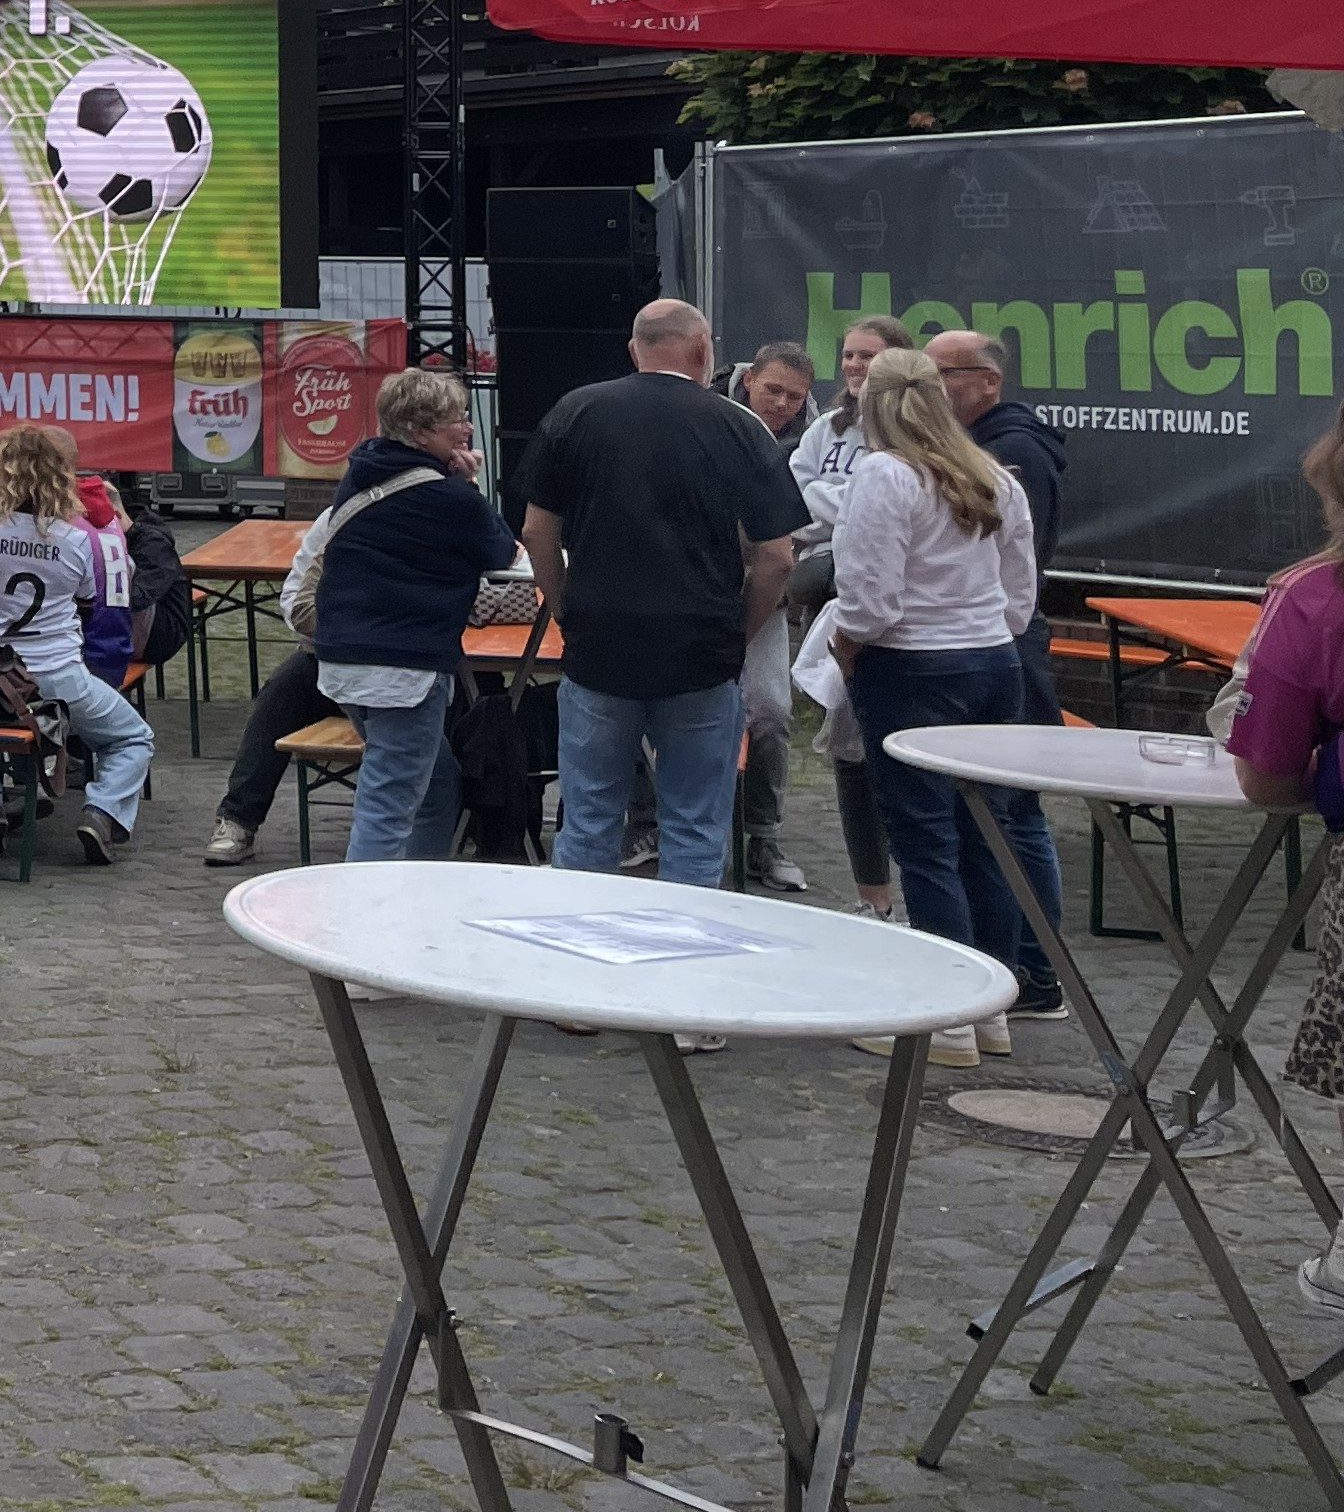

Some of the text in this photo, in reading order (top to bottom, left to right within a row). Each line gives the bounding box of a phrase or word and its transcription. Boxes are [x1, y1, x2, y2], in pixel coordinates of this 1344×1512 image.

[292, 388, 353, 418] Sport
[1035, 404, 1251, 436] STOFFZENTRUM.DE
[0, 535, 61, 562] RÜDIGER
[1, 571, 46, 637] 2
